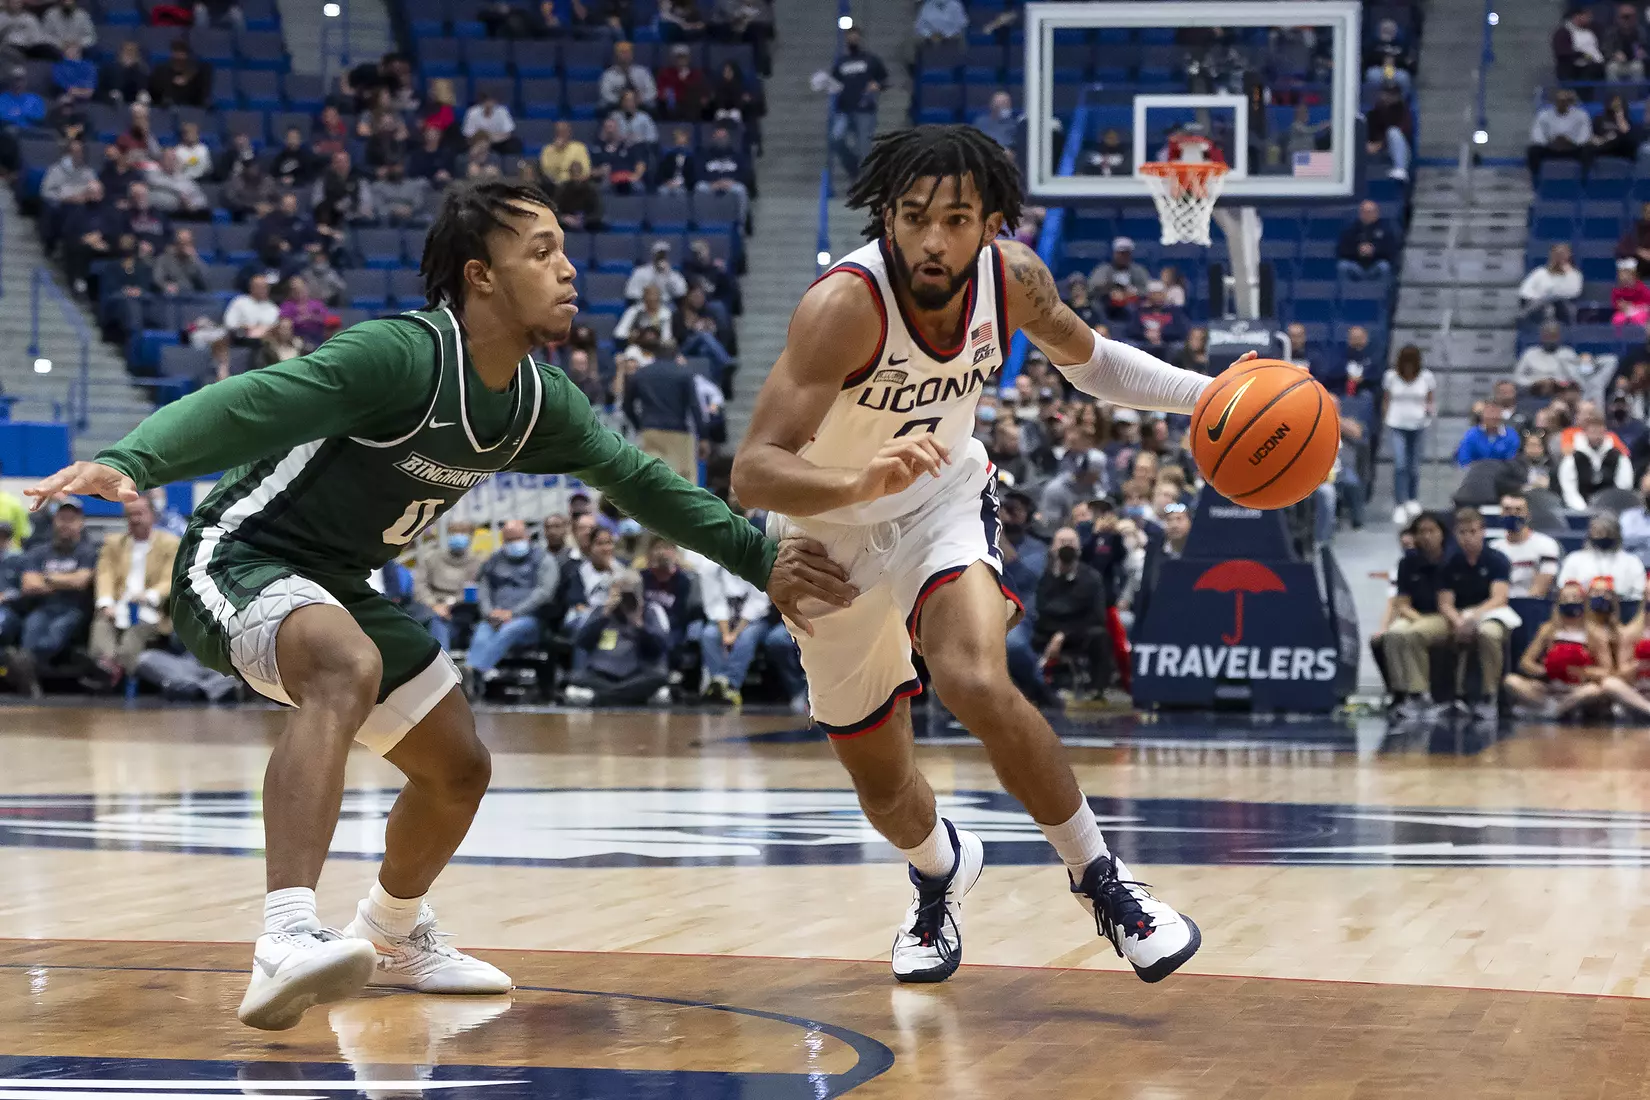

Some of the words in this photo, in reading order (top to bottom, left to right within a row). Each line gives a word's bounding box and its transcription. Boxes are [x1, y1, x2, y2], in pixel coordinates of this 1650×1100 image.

[857, 365, 996, 413] UCONN
[1248, 422, 1291, 466] UCONN
[382, 498, 445, 545] 0
[1134, 643, 1338, 680] TRAVELERS
